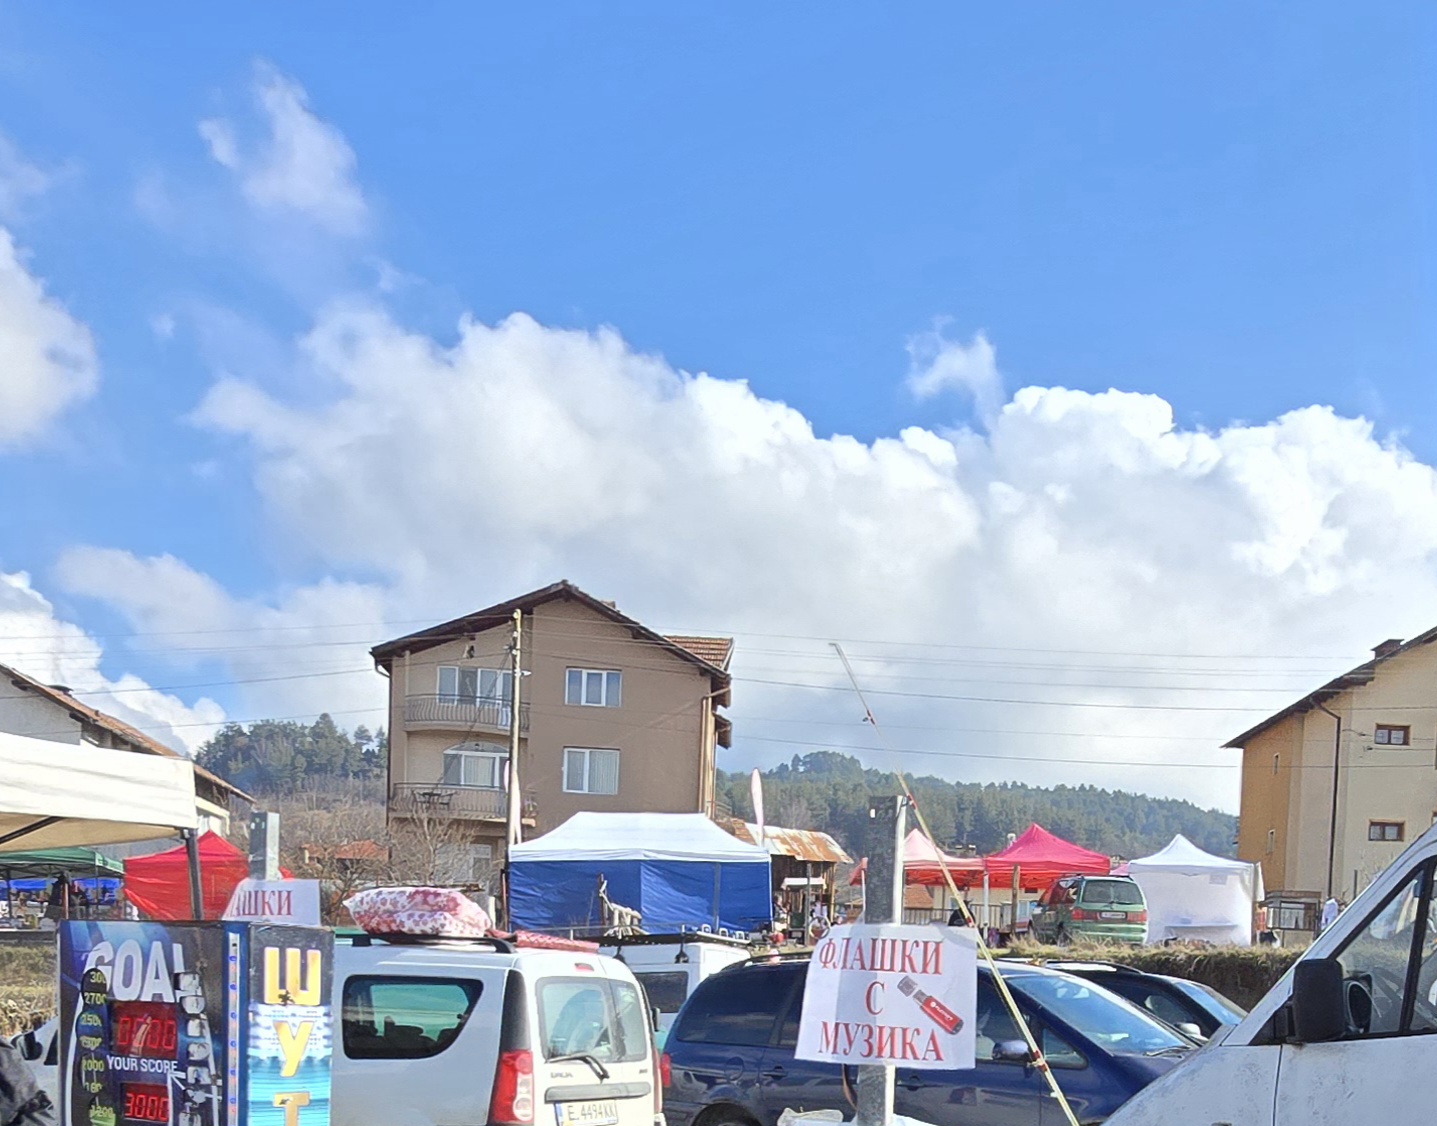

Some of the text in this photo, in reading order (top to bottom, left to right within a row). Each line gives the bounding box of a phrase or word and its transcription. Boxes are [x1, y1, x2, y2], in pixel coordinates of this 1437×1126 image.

[83, 938, 204, 1004] GOAL
[818, 936, 944, 976] ФЛАШКИ
[865, 981, 887, 1016] С
[817, 1021, 945, 1062] МУЗИКА
[106, 1054, 178, 1074] YOUR SCORE
[125, 1092, 170, 1123] 3000
